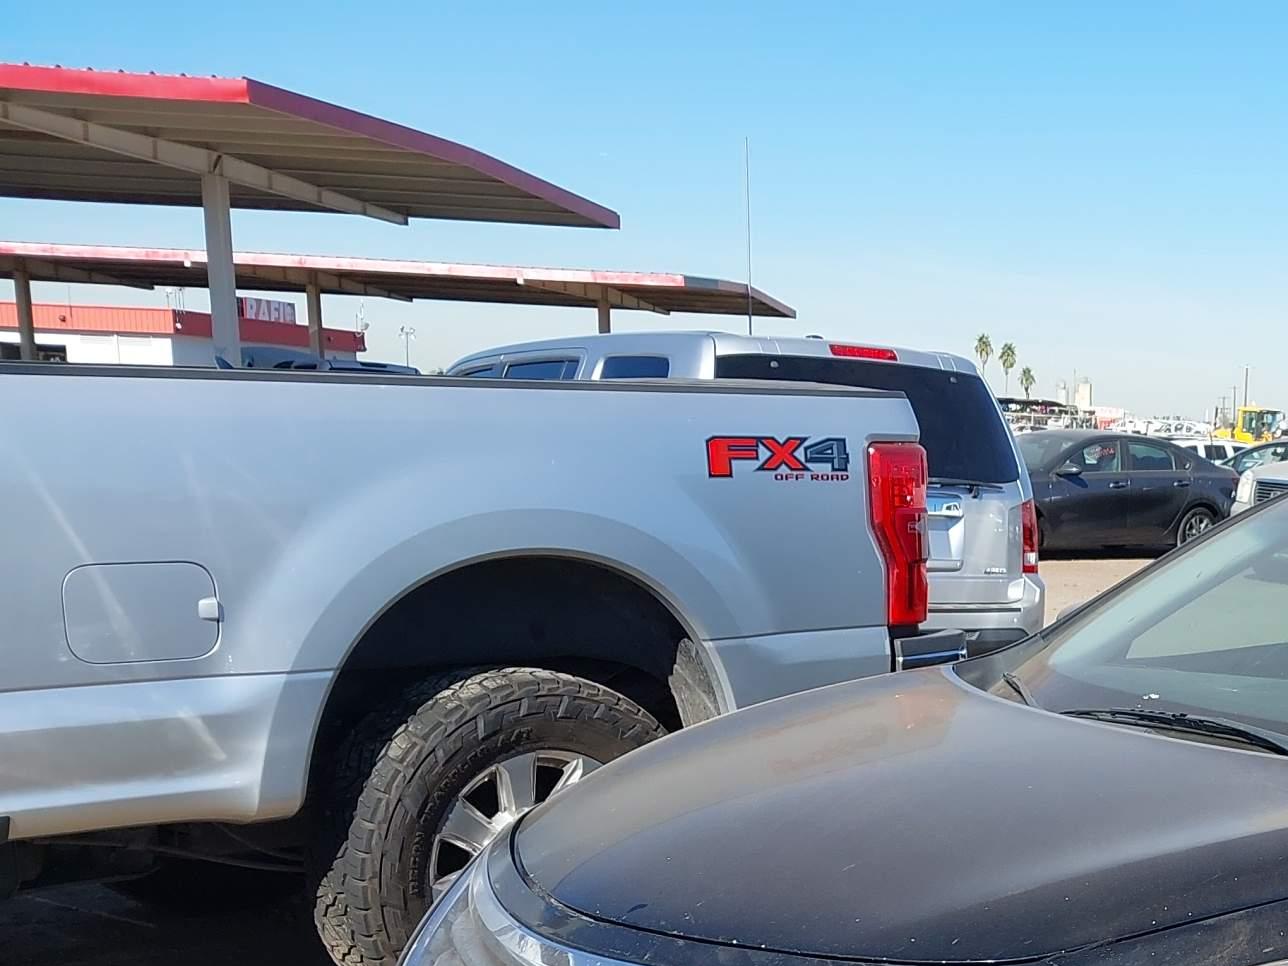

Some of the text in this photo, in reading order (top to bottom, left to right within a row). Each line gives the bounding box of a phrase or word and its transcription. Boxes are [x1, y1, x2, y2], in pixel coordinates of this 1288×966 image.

[706, 436, 850, 478] FX4
[774, 473, 850, 481] OFF ROAD
